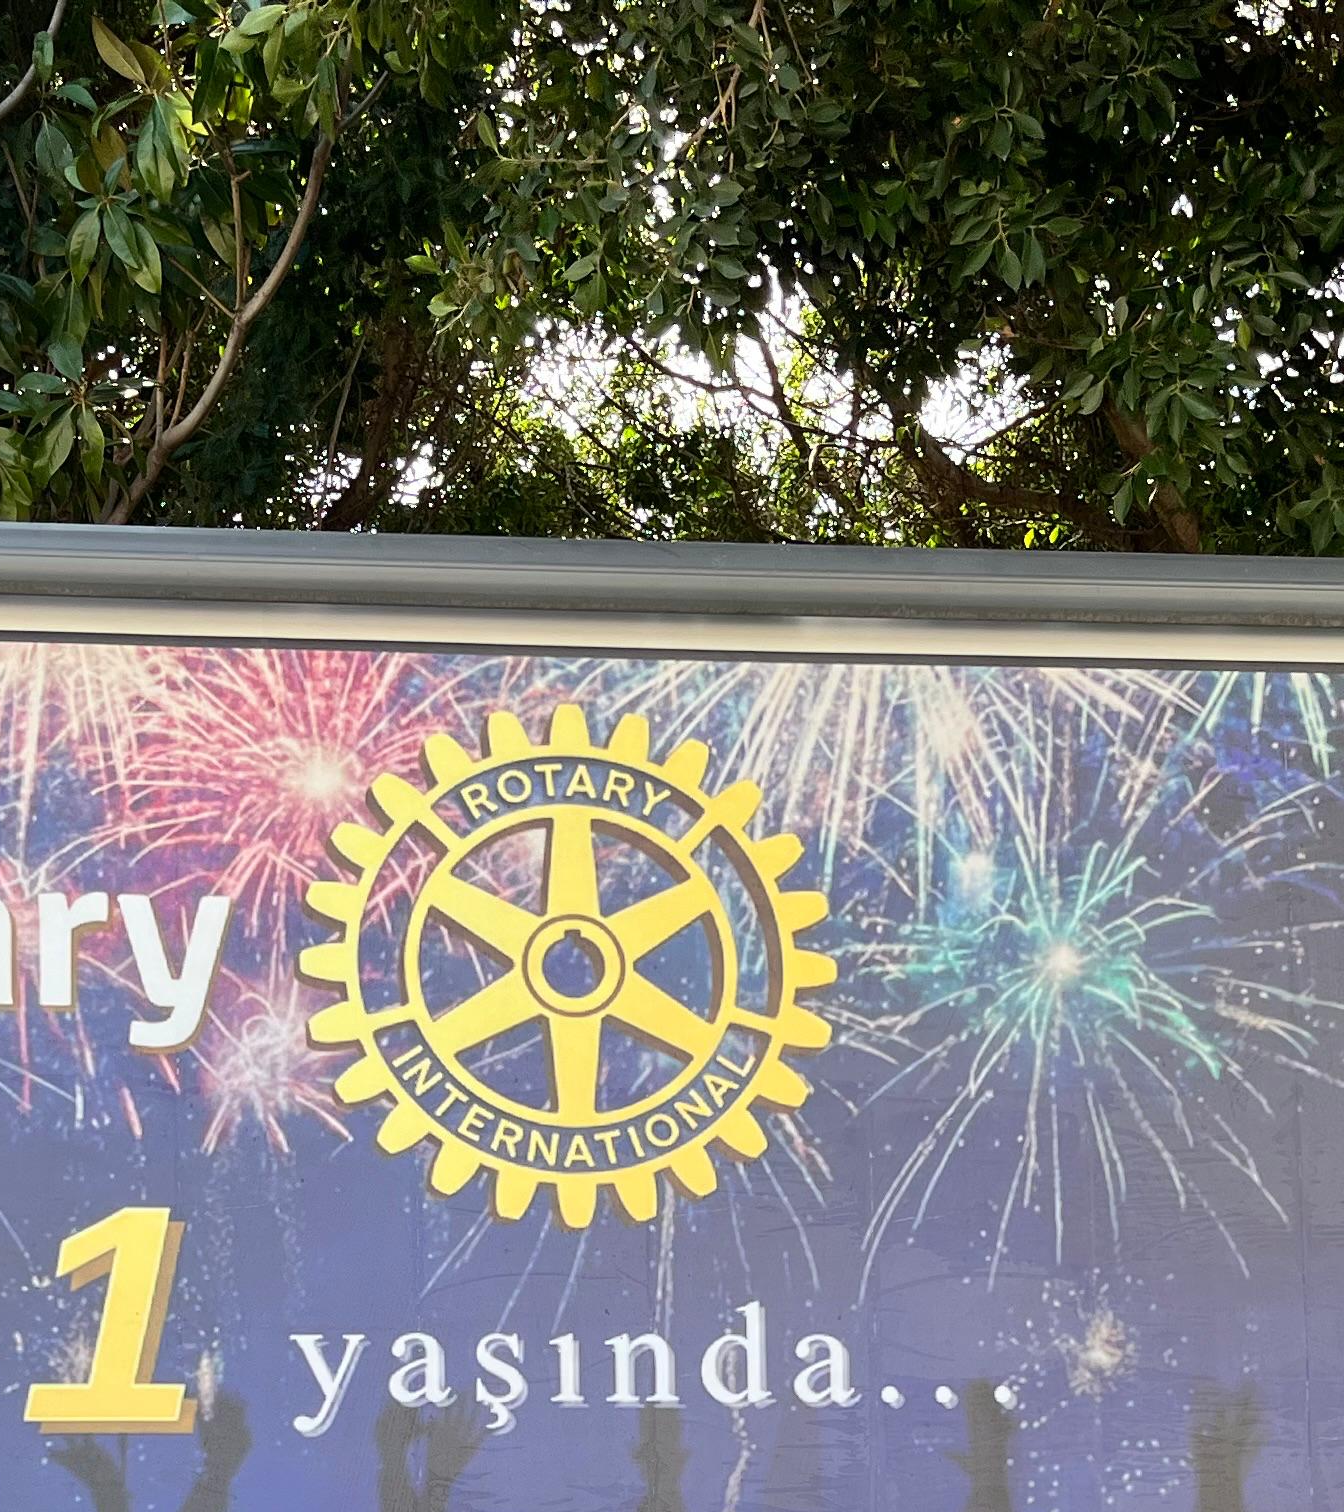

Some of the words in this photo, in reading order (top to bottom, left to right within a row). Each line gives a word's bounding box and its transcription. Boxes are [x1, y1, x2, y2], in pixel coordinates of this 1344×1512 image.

[461, 763, 673, 820] ROTARY
[391, 1043, 757, 1169] INTERNATIONAL
[288, 1300, 1020, 1438] yaşında...
